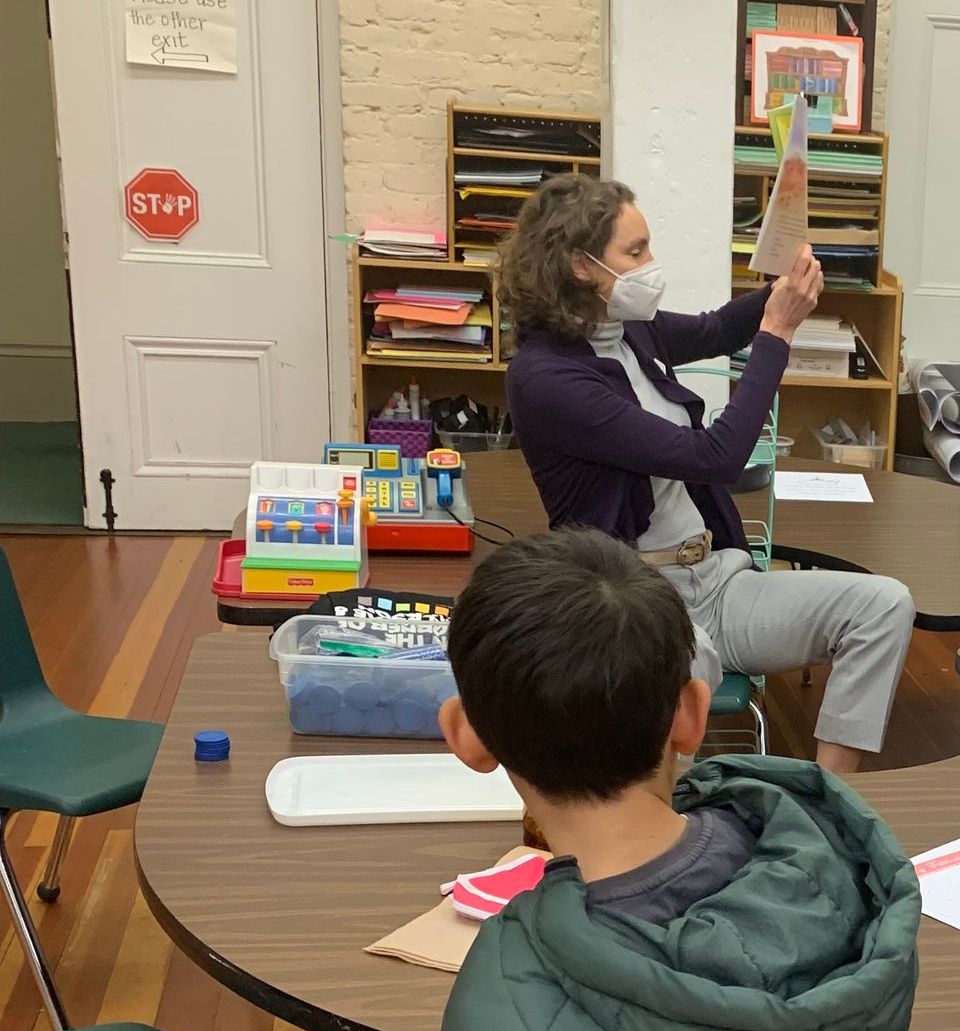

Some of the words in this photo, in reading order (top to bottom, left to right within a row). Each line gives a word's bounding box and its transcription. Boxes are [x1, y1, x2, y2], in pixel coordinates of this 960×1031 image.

[130, 9, 156, 26] the
[160, 11, 208, 31] other
[151, 31, 190, 48] exit
